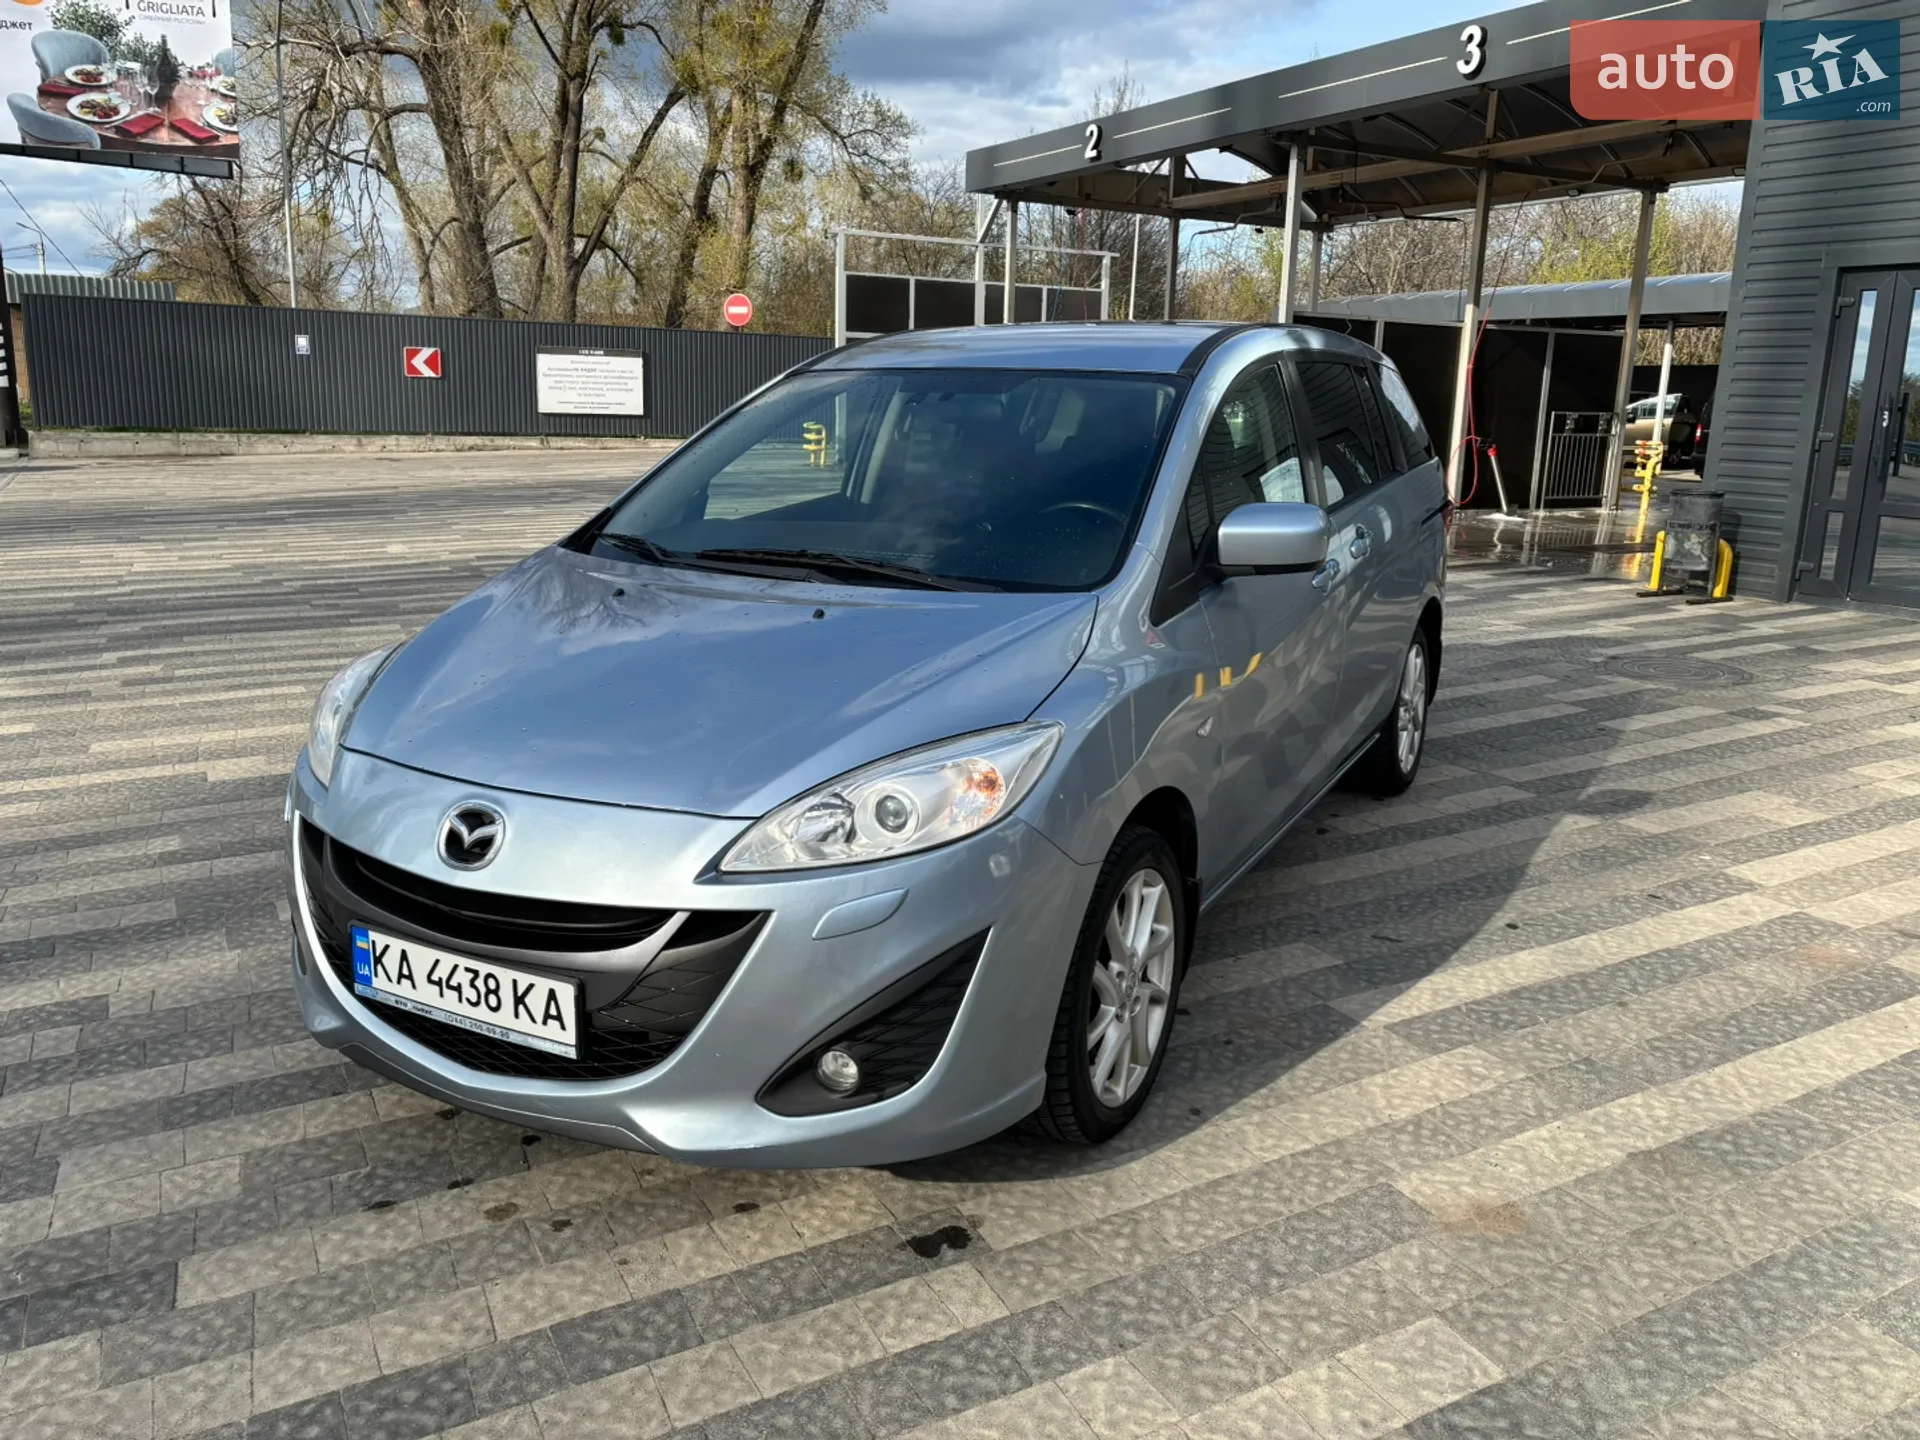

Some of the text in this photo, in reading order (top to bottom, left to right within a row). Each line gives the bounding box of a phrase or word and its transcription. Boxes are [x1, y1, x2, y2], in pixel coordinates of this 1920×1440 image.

[137, 1, 206, 17] GRIGLIATA
[1456, 25, 1483, 75] 3
[1084, 124, 1099, 160] 2
[357, 962, 371, 976] UA
[371, 939, 567, 1031] KA 4438 KA
